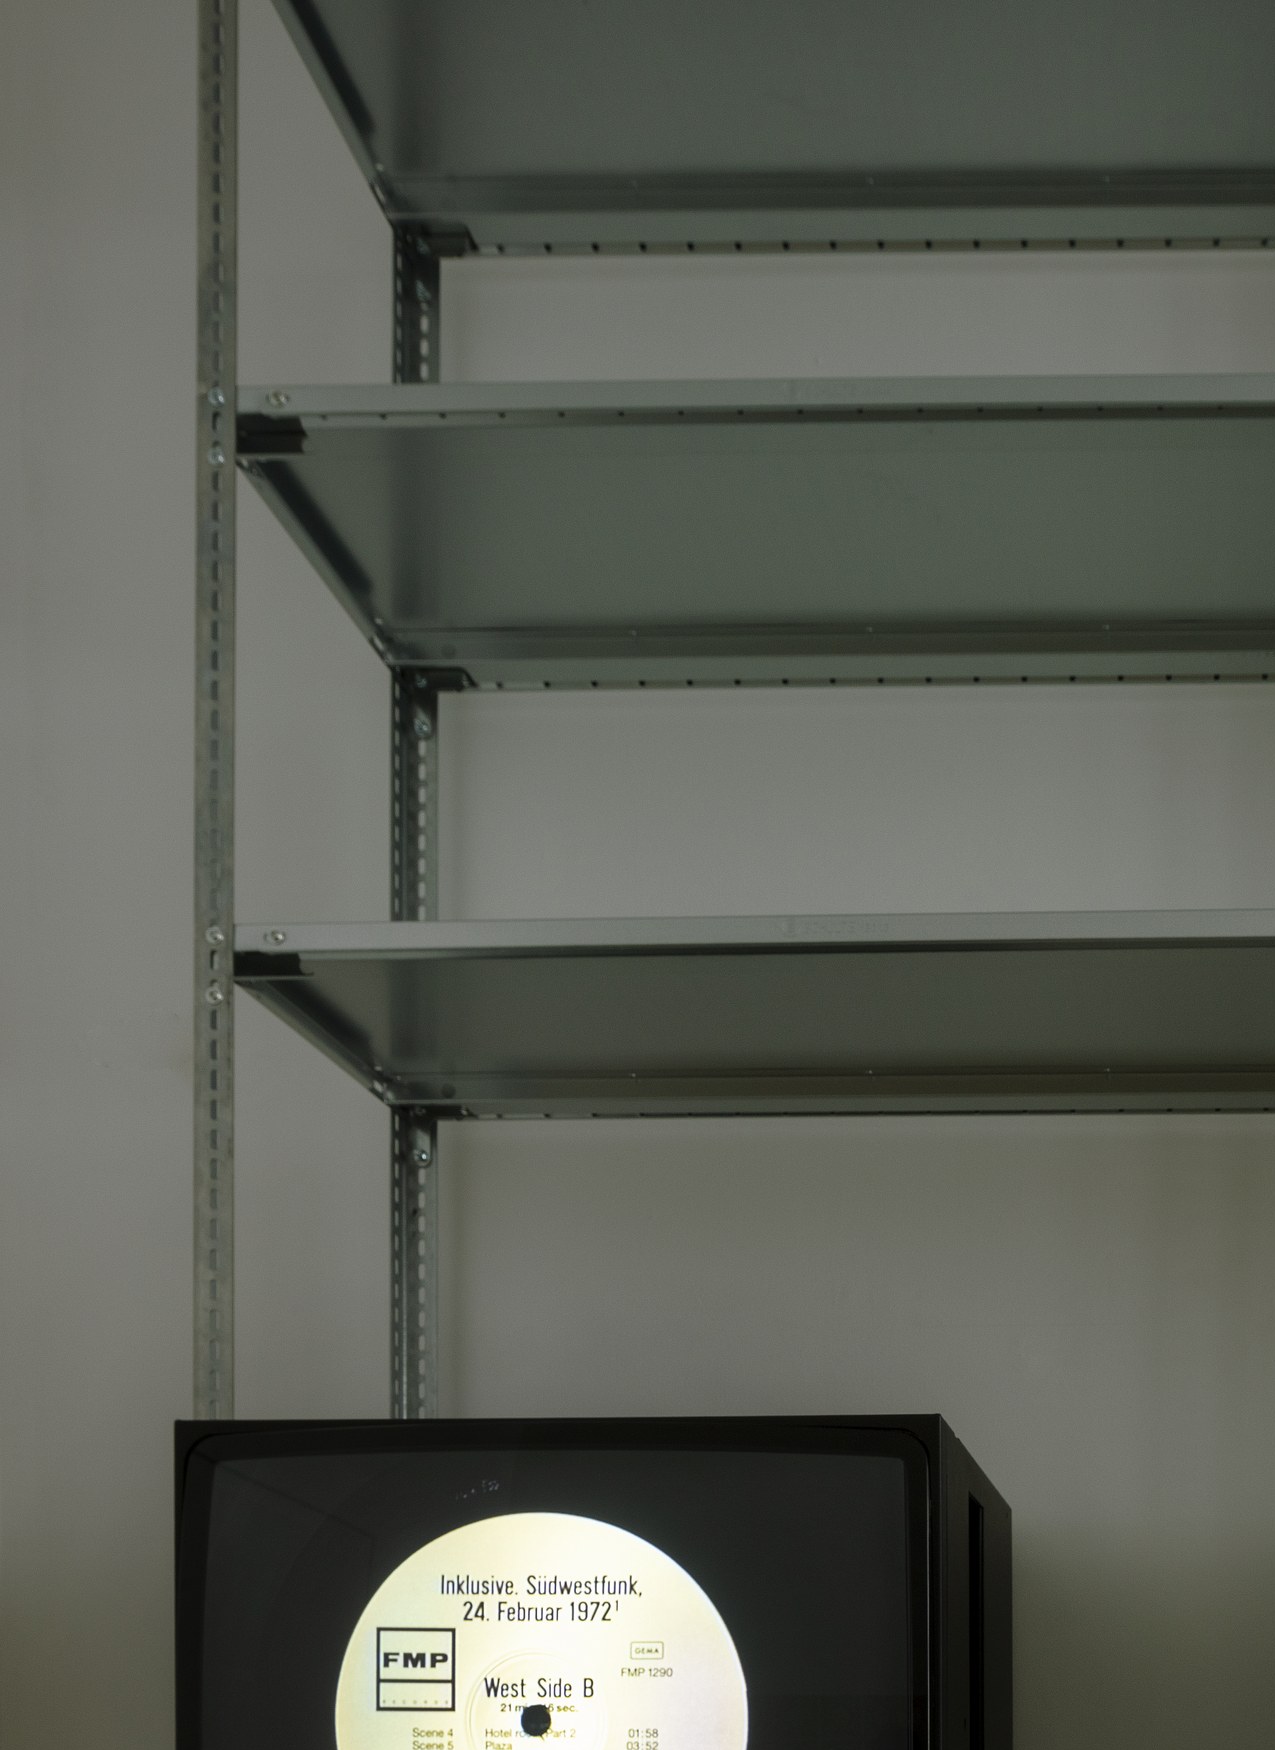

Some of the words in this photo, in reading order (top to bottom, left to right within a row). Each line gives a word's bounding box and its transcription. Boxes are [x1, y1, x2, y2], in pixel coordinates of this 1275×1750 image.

[441, 1575, 517, 1595] Inklusive.
[527, 1575, 642, 1596] Südwestfunk,
[464, 1601, 489, 1621] 24.
[498, 1602, 562, 1621] Februar
[383, 1652, 448, 1668] FMP
[620, 1667, 646, 1678] FMP
[648, 1667, 673, 1678] 1290
[484, 1677, 525, 1697] West
[537, 1678, 571, 1698] Side
[584, 1678, 593, 1697] B
[501, 1703, 511, 1712] 21
[412, 1728, 445, 1738] Scene
[447, 1728, 454, 1738] 4
[485, 1728, 512, 1738] Hotel
[546, 1728, 567, 1738] Part
[569, 1728, 577, 1738] 2
[628, 1728, 659, 1738] 01:58
[412, 1741, 445, 1750] Scene
[447, 1741, 454, 1750] 5
[485, 1741, 513, 1750] Plaza
[626, 1741, 659, 1750] 03:52
